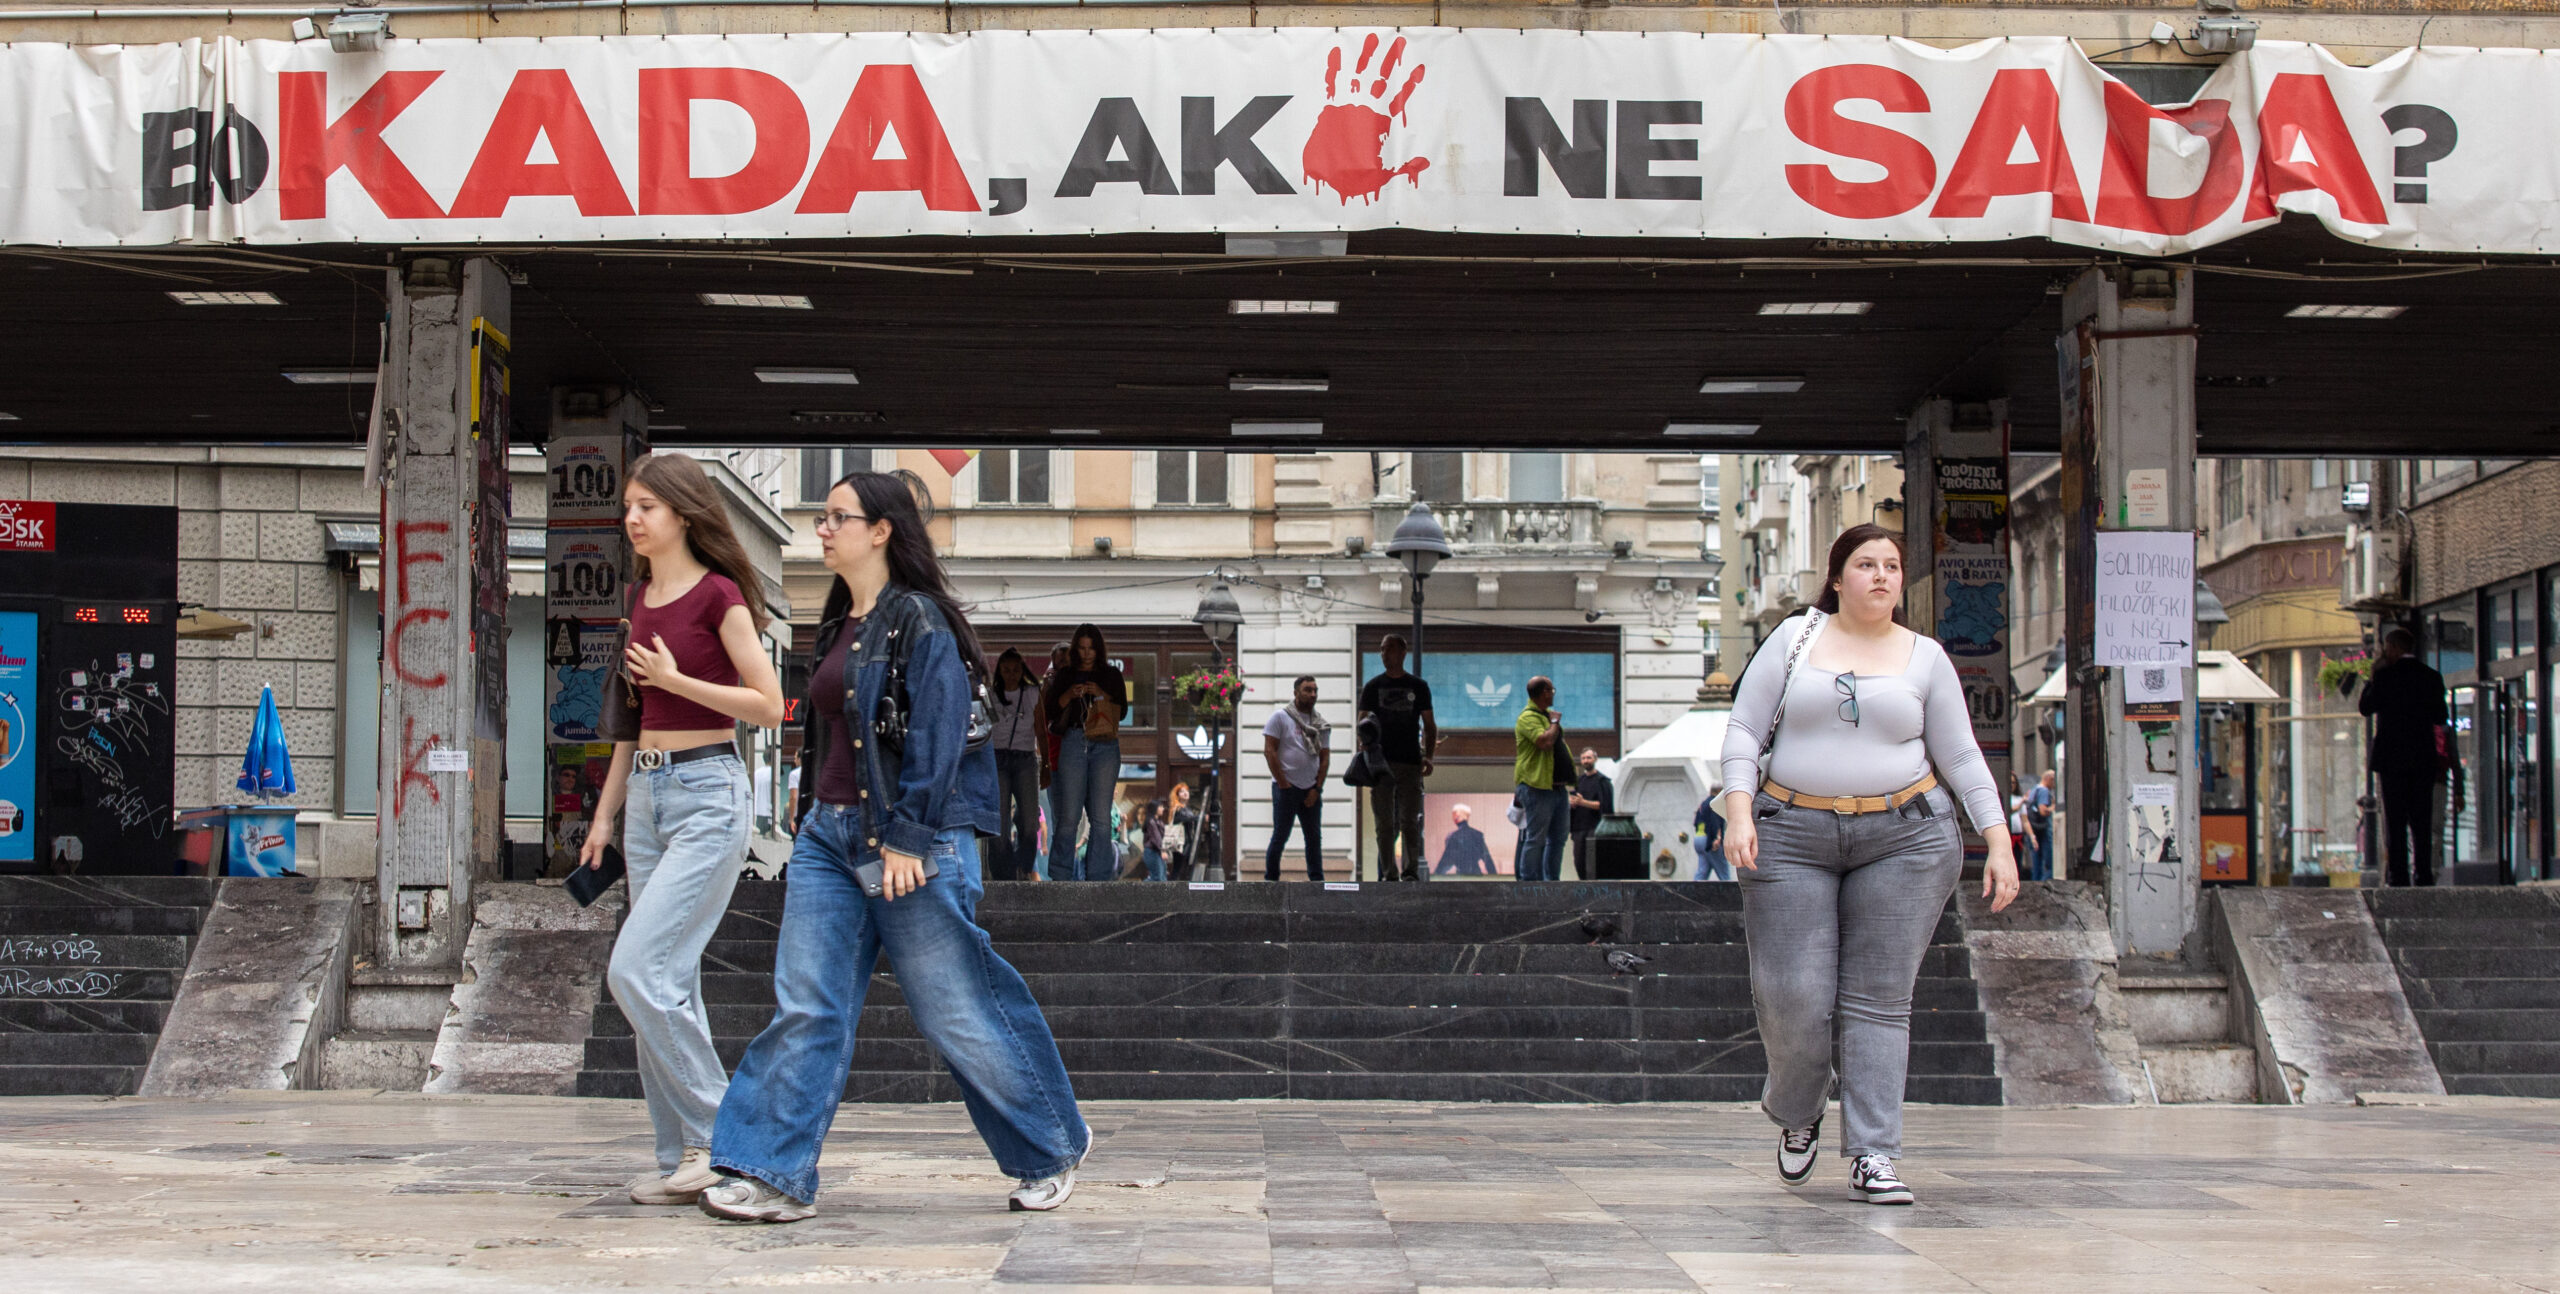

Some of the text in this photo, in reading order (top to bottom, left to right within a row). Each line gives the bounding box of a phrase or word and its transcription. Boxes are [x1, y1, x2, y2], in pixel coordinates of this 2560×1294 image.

[1504, 97, 1702, 200] NE
[1941, 463, 1997, 478] OBOJENI
[552, 463, 616, 499] 100
[1939, 476, 2003, 490] PROGRAM
[552, 500, 617, 508] ANNIVERSARY
[1938, 558, 2006, 568] AVIO KARTE
[551, 562, 616, 598] 100
[1944, 568, 2002, 580] NA 8 RATA
[2135, 581, 2157, 594] UZ
[551, 599, 617, 607] ANNIVERSARY
[2100, 594, 2187, 617] FILOZOFSKI
[2131, 617, 2171, 641] NIŠU
[582, 643, 617, 652] KART
[1963, 685, 2003, 721] 00
